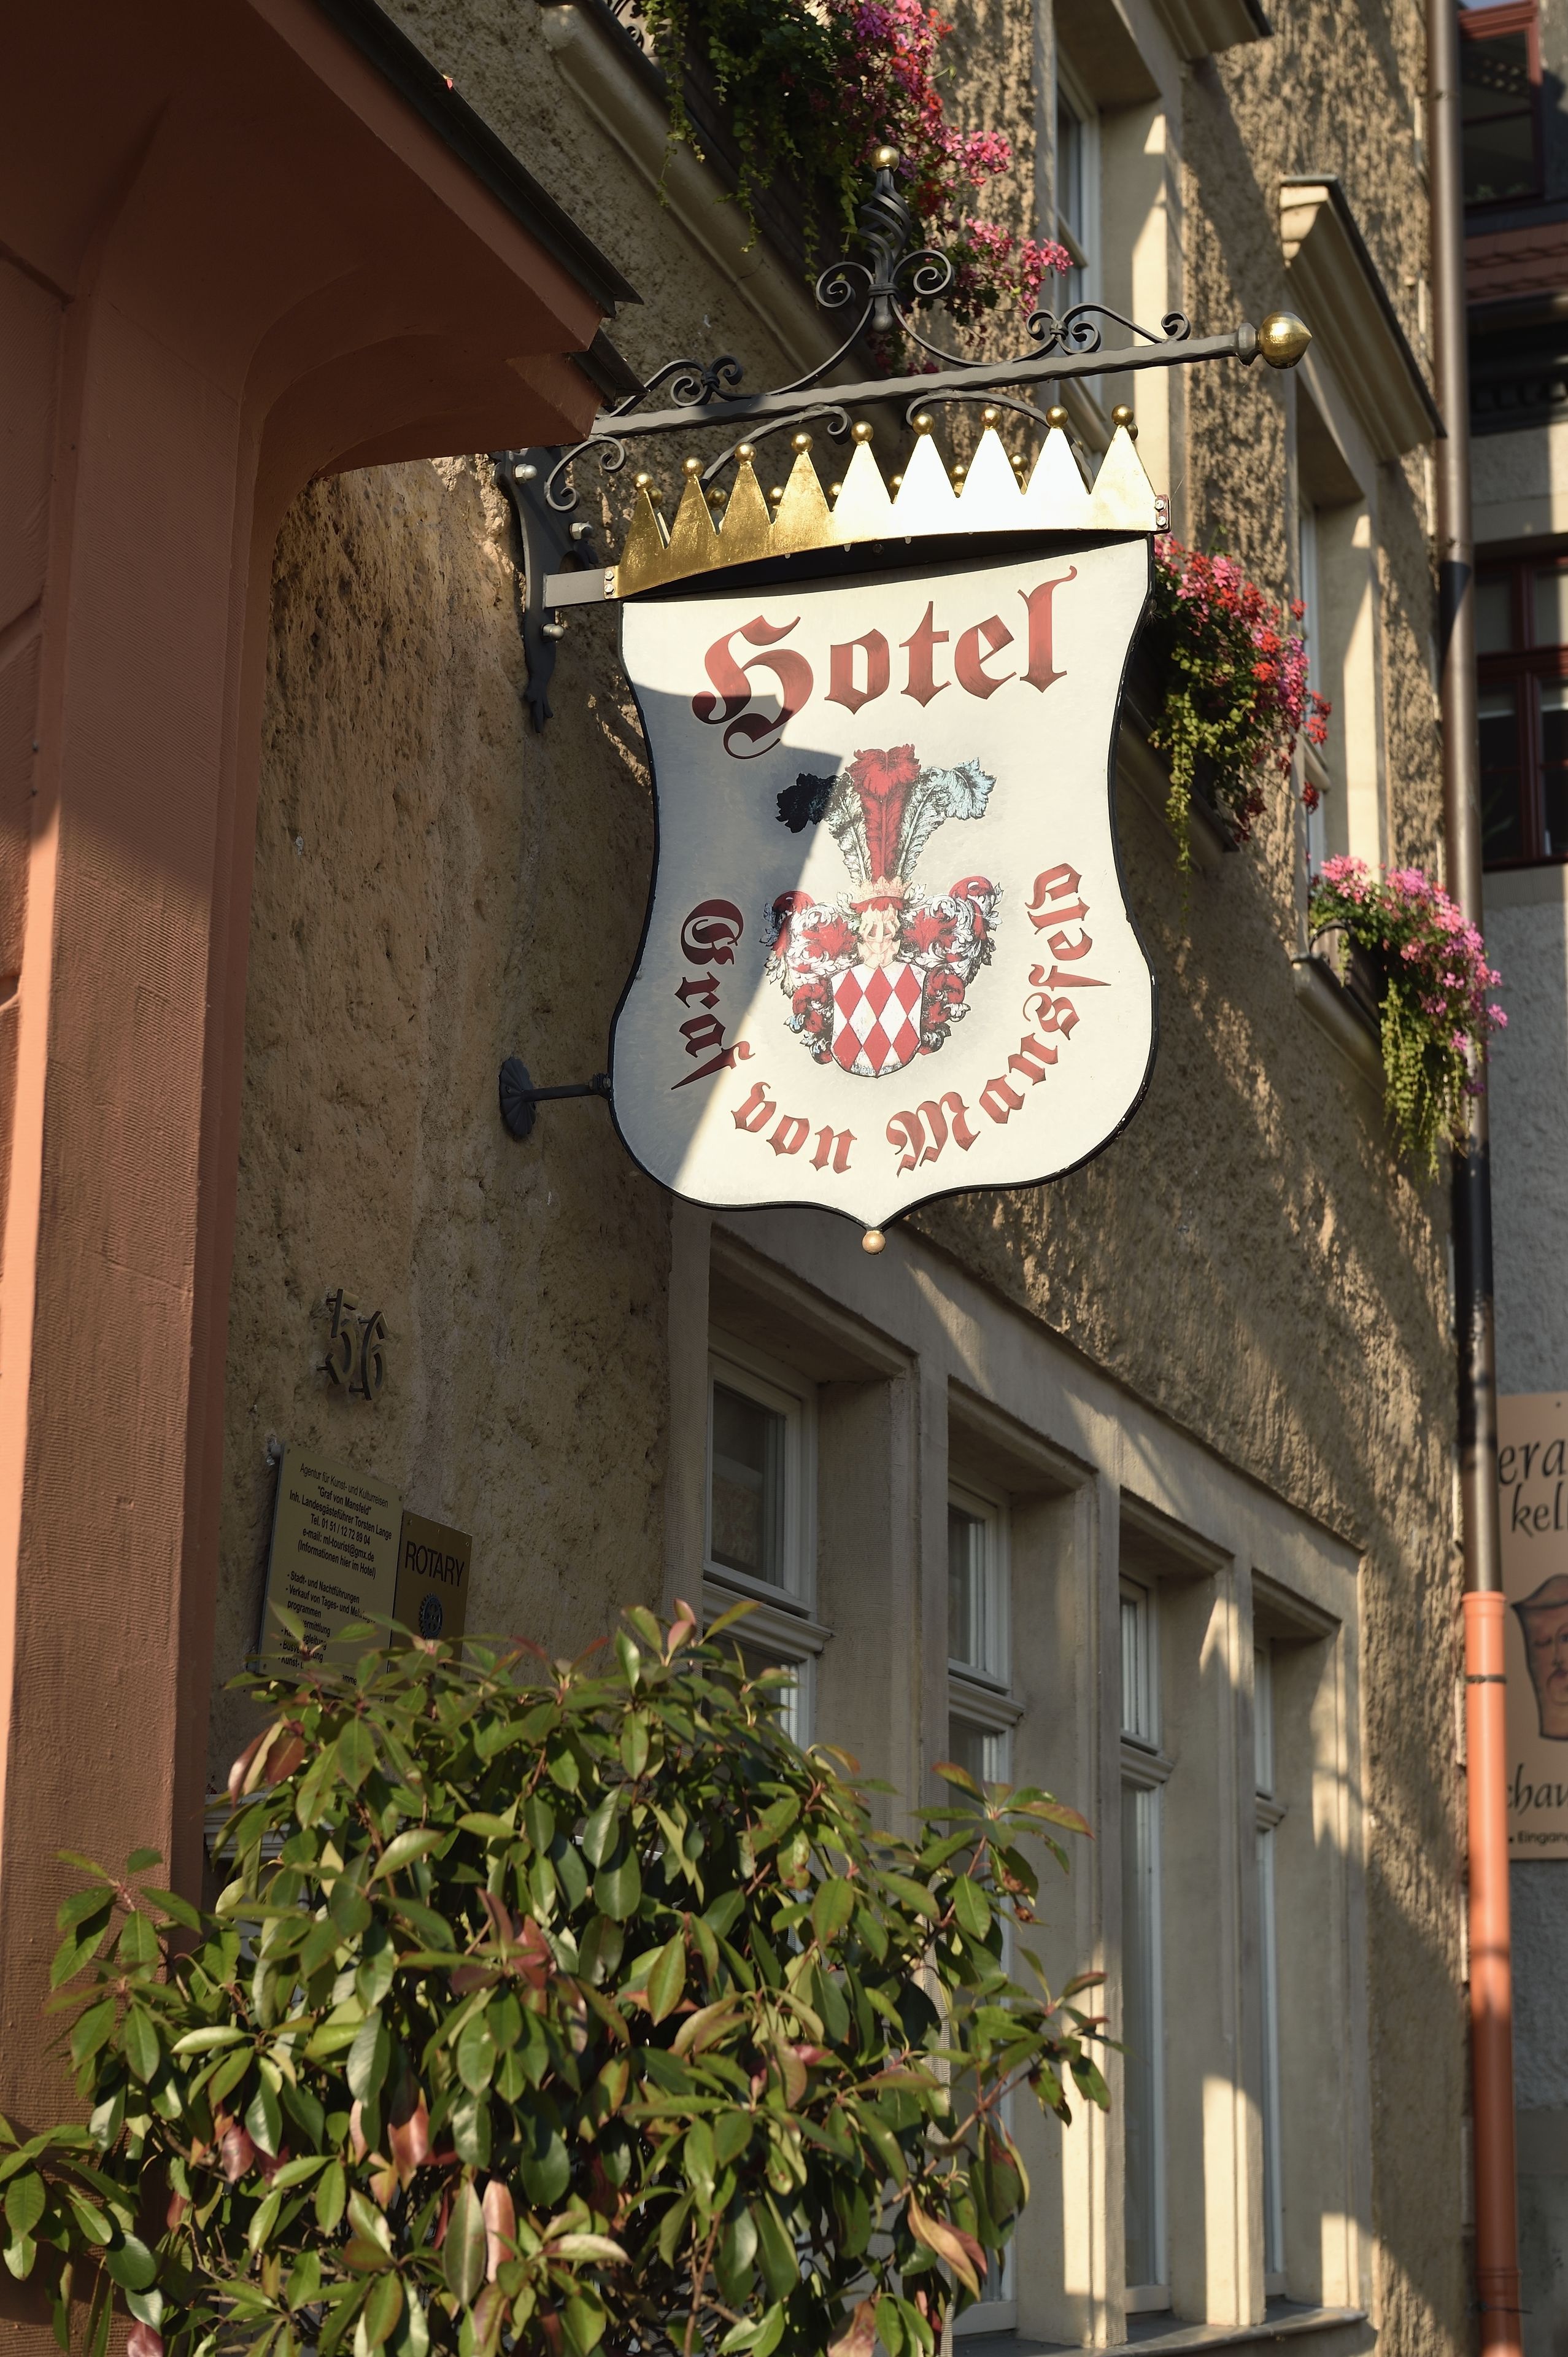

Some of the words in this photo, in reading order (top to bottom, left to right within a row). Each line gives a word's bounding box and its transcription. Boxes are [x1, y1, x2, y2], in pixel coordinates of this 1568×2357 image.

[692, 565, 1077, 760] Hotel
[671, 899, 756, 1091] Graf
[731, 1081, 857, 1174] von
[886, 862, 1111, 1178] Mansfeld
[325, 1288, 390, 1400] 56
[300, 1463, 321, 1480] Agentur
[322, 1472, 330, 1484] für
[330, 1475, 347, 1490] Kunst-
[348, 1482, 358, 1496] und
[358, 1487, 388, 1507] Kulturreisen
[333, 1493, 344, 1505] von
[290, 1490, 301, 1503] Inh.
[301, 1495, 354, 1523] Landesgästeführer
[355, 1515, 375, 1533] Torsten
[376, 1524, 392, 1541] Lange
[311, 1513, 320, 1527] Tel.
[321, 1518, 328, 1529] 01
[330, 1521, 336, 1532] 51
[341, 1525, 347, 1536] 12
[348, 1528, 355, 1539] 72
[356, 1531, 362, 1542] 89
[363, 1534, 371, 1546] 04
[298, 1539, 339, 1564] (Informationen
[340, 1554, 351, 1568] hier
[352, 1559, 359, 1571] im
[360, 1562, 376, 1580] Hotel)
[303, 1528, 322, 1542] e-mail:
[323, 1535, 374, 1562] ml-tourist@gmx.de
[405, 1541, 465, 1587] ROTARY
[289, 1584, 310, 1600] Verkauf
[311, 1594, 320, 1604] von
[322, 1596, 339, 1609] Tages-
[339, 1603, 350, 1614] und
[290, 1571, 307, 1584] Stadt-
[307, 1579, 318, 1589] und
[319, 1581, 360, 1604] Nachtführungen
[287, 1600, 322, 1619] programmen
